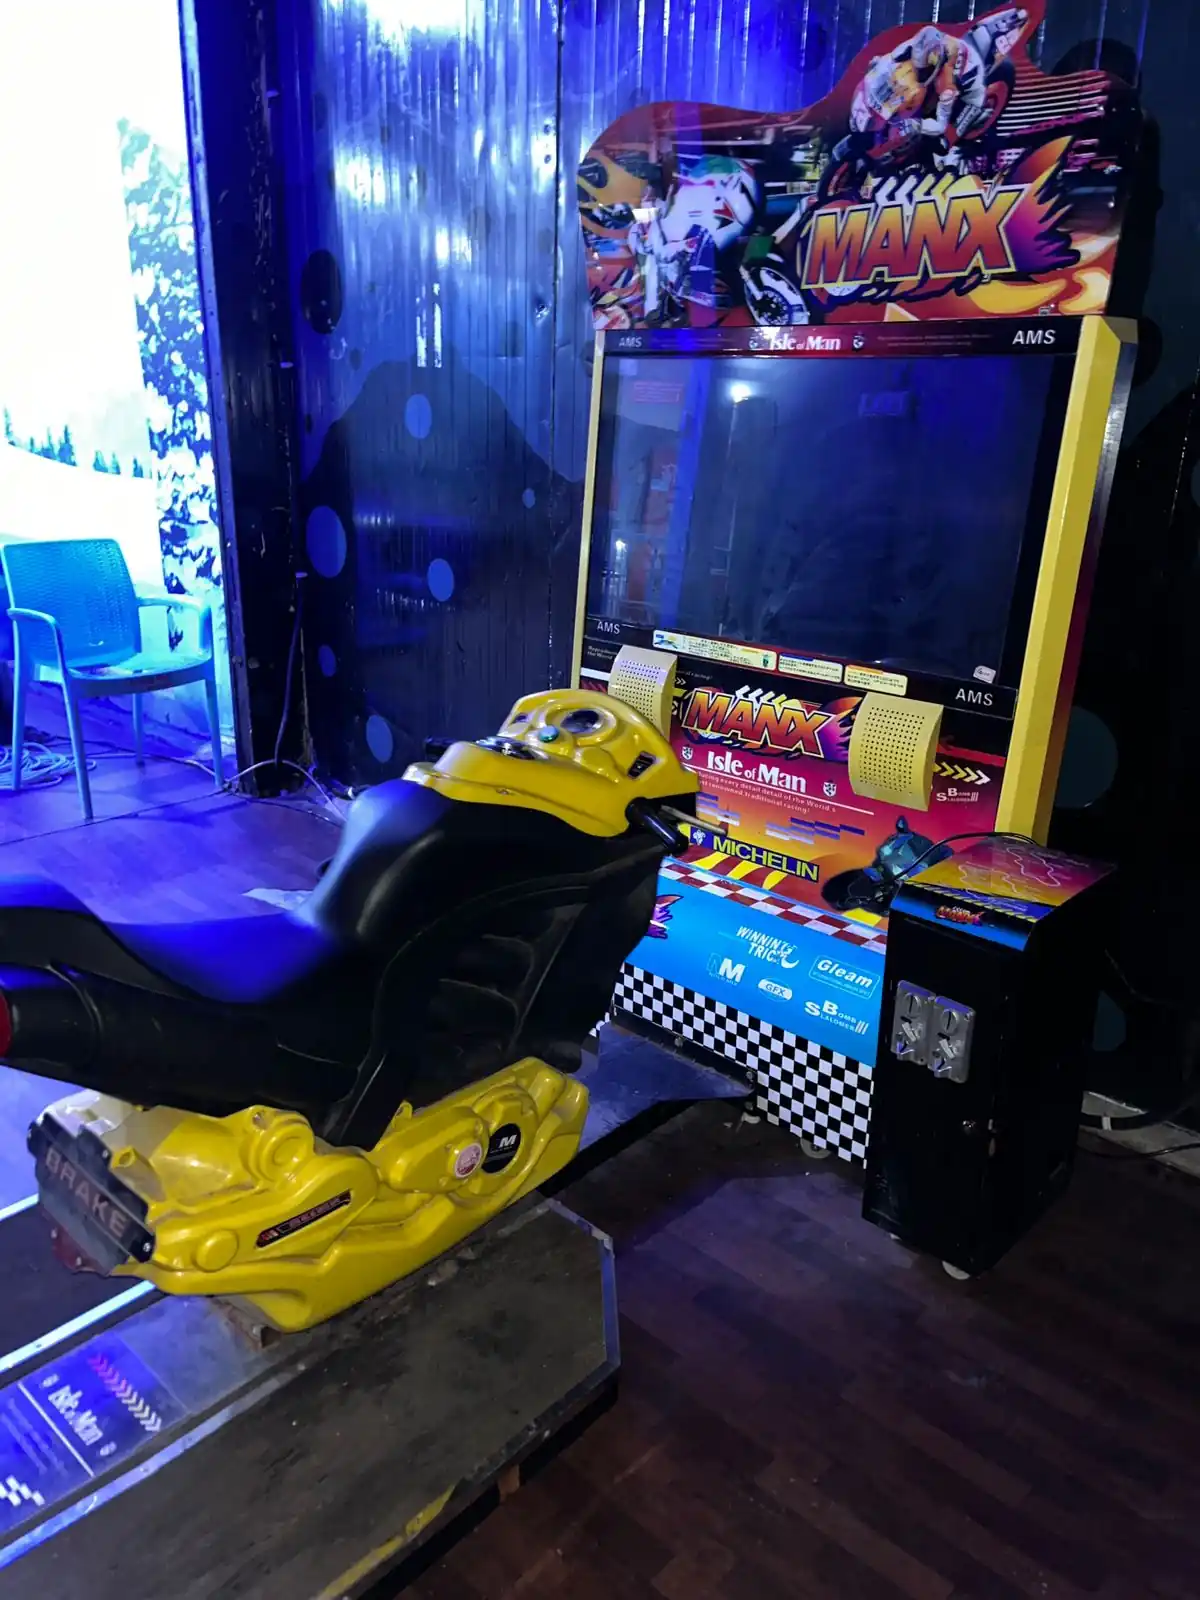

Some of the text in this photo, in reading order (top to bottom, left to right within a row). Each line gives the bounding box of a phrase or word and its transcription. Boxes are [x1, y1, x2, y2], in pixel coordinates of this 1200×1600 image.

[801, 182, 1031, 289] MANX
[619, 336, 642, 347] AMS
[769, 333, 795, 350] Isle
[805, 336, 841, 350] Man
[1012, 329, 1056, 345] AMS
[597, 621, 620, 635] AMS
[955, 688, 994, 706] AMS
[681, 688, 836, 759] MANX
[707, 751, 807, 793] Isle of Man
[712, 835, 819, 881] MICHELIN
[817, 959, 874, 989] Gleam
[765, 982, 786, 998] GFX
[46, 1146, 129, 1238] BRAKE
